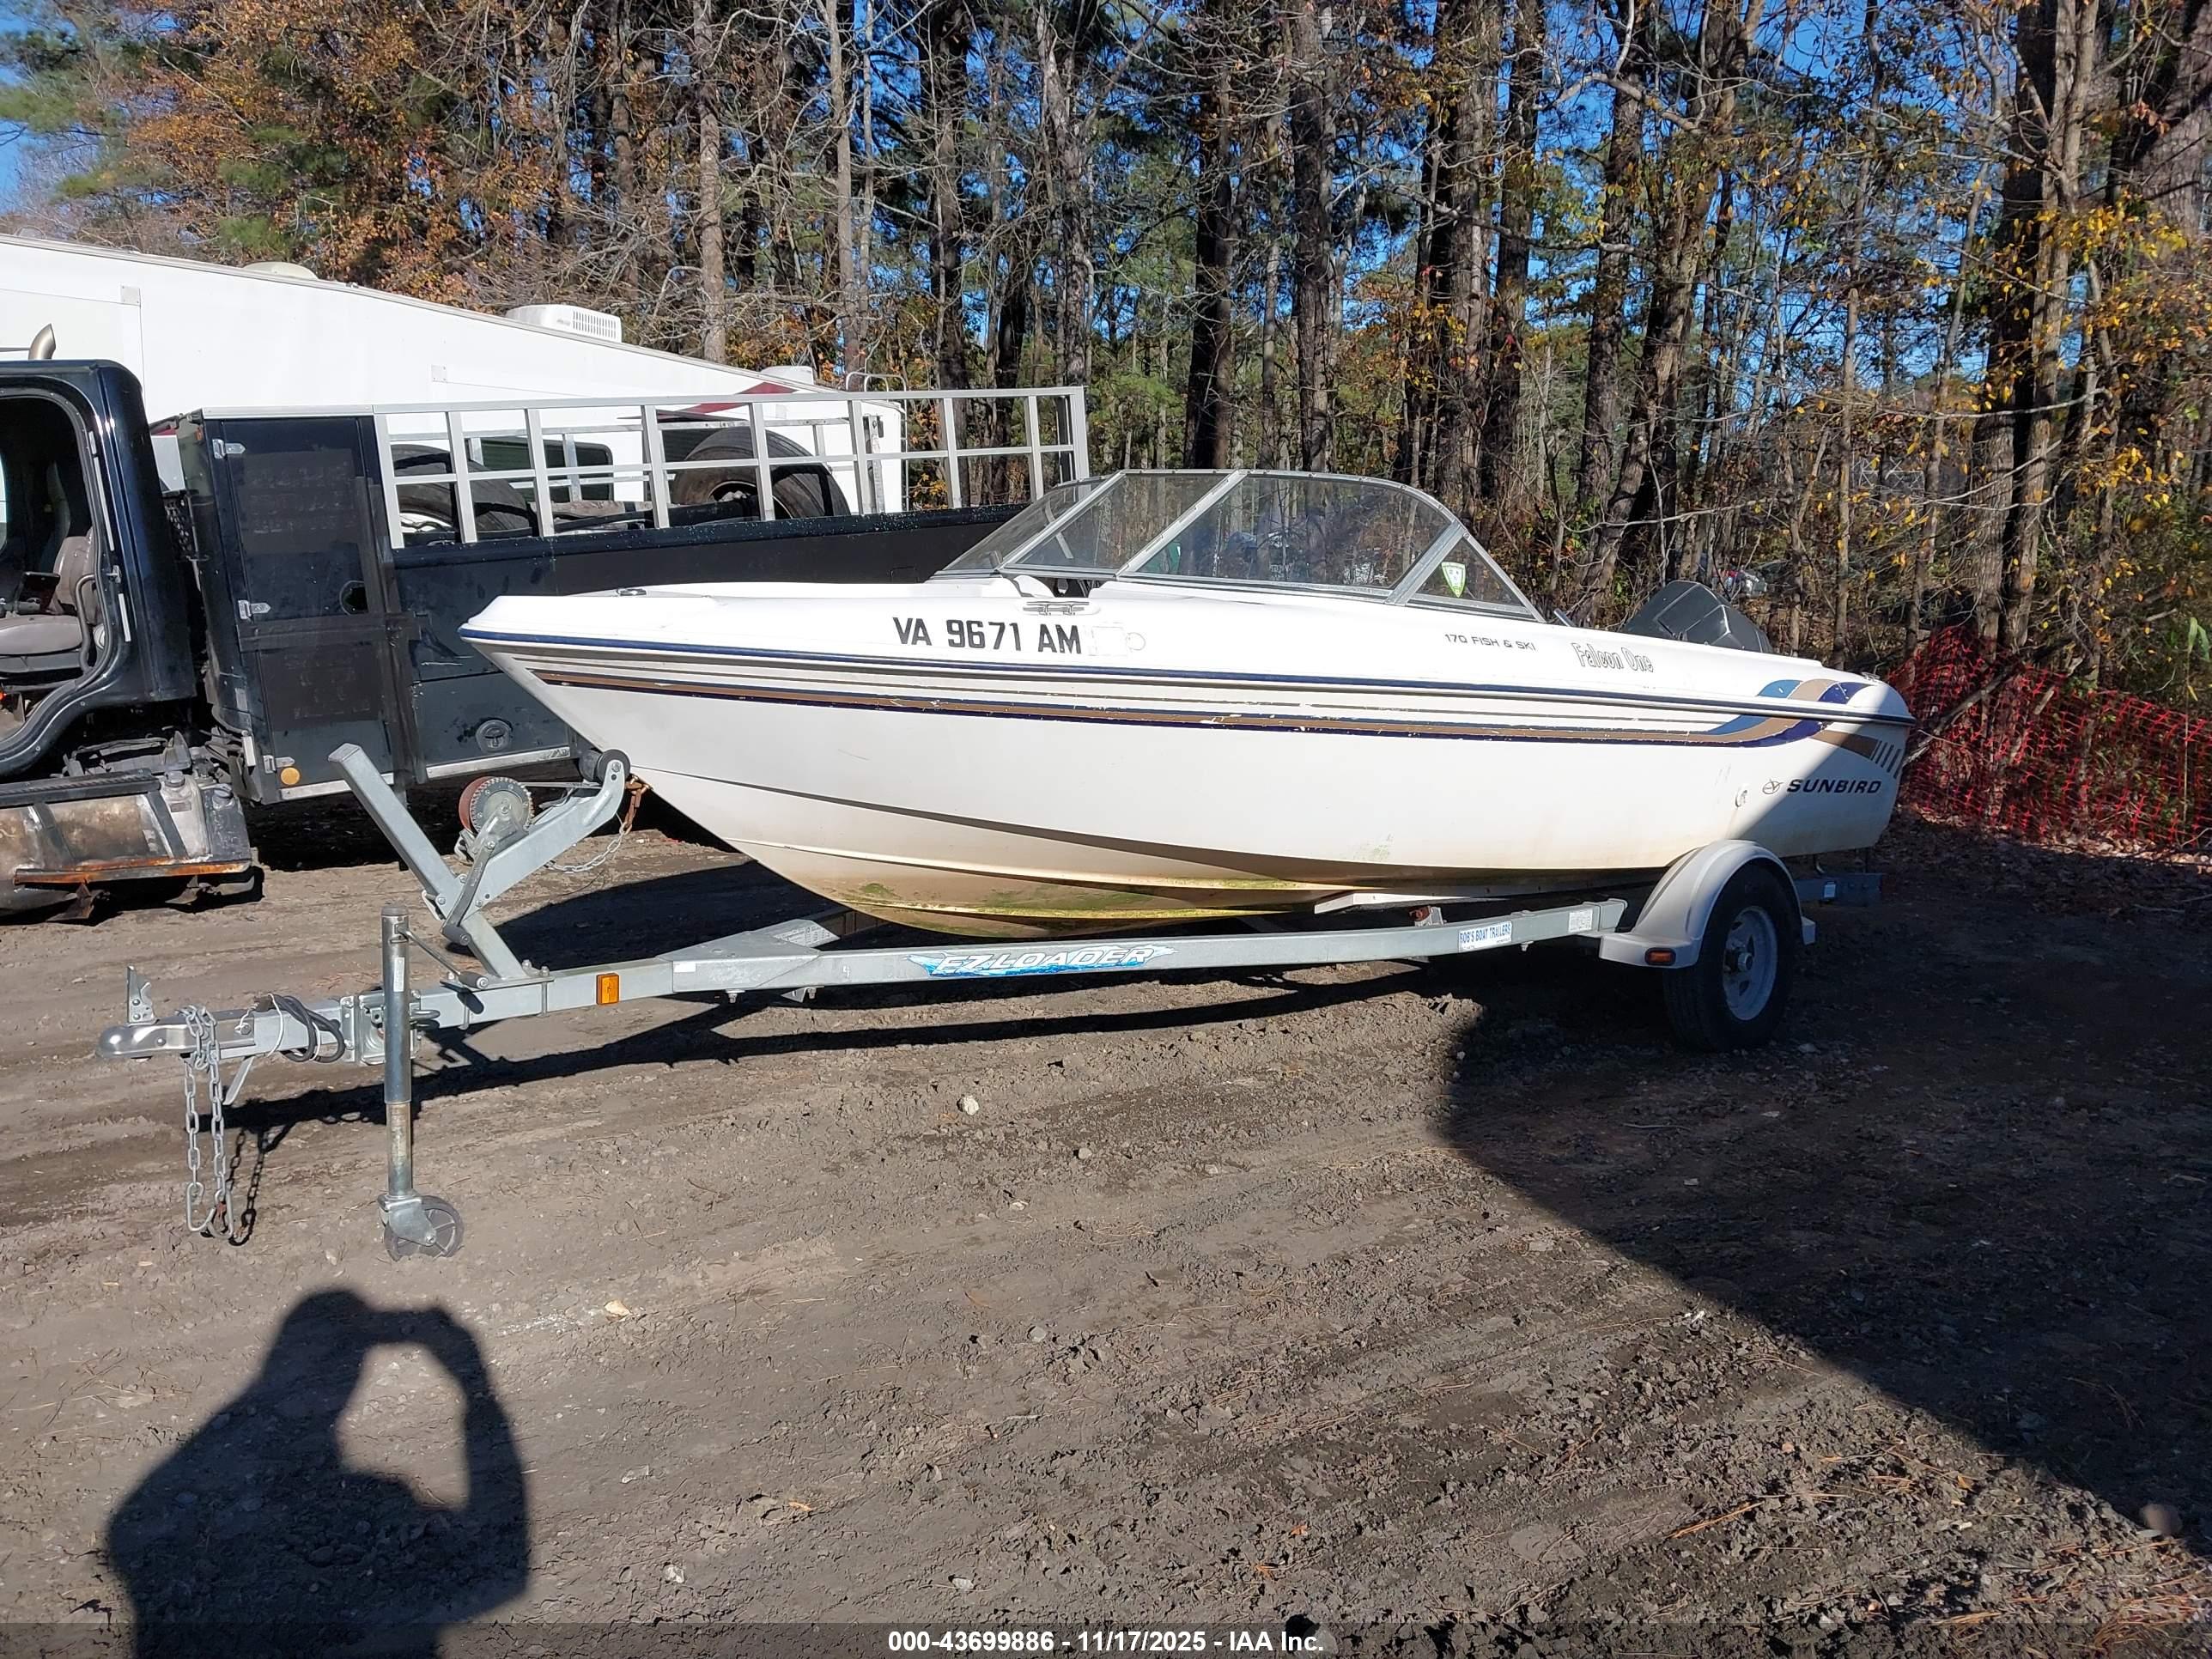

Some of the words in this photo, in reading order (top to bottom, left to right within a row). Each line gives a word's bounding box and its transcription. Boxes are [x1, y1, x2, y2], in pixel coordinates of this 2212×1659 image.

[892, 617, 933, 647] VA
[945, 619, 1022, 651] 9671
[1037, 623, 1082, 654] AM
[1444, 633, 1468, 644] 170
[1471, 635, 1500, 647] FISH
[1503, 639, 1513, 648] &
[1515, 641, 1537, 652] SKI
[1571, 642, 1625, 670] Falcon
[1620, 646, 1654, 673] One
[1786, 778, 1883, 794] SUNBIRD
[1475, 927, 1488, 942] BOAT
[1489, 922, 1511, 939] TRAILERS
